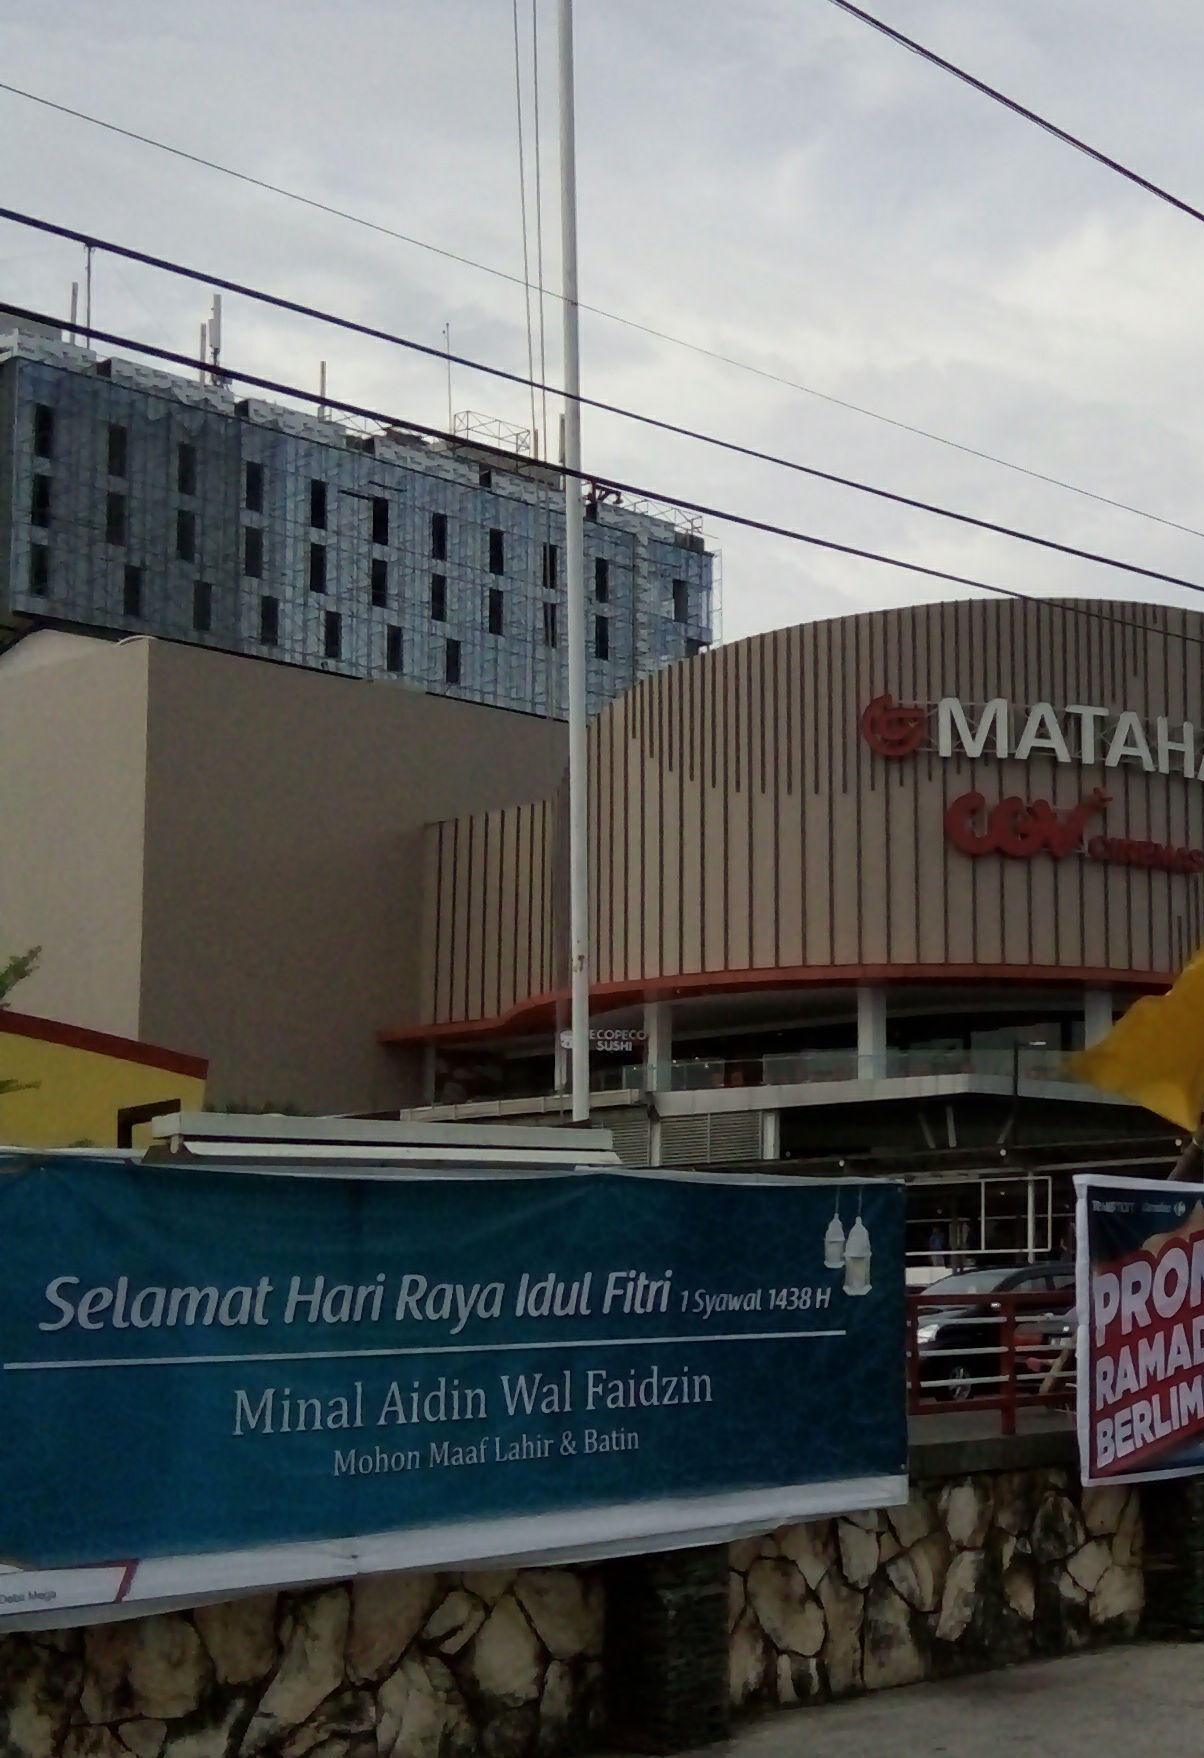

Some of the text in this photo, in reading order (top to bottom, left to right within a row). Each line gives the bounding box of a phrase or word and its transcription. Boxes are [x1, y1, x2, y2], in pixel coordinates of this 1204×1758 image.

[945, 788, 1108, 858] CGV
[589, 1029, 647, 1041] ECOPECO
[596, 1040, 632, 1051] SUSHI
[38, 1269, 831, 1335] Selamat Hari Raya Idul Fitri 1 Syawal 1438 H
[232, 1365, 713, 1436] Minal Aidin Wal Faidzin
[333, 1427, 639, 1477] Mohon Maaf Lahir & Batin
